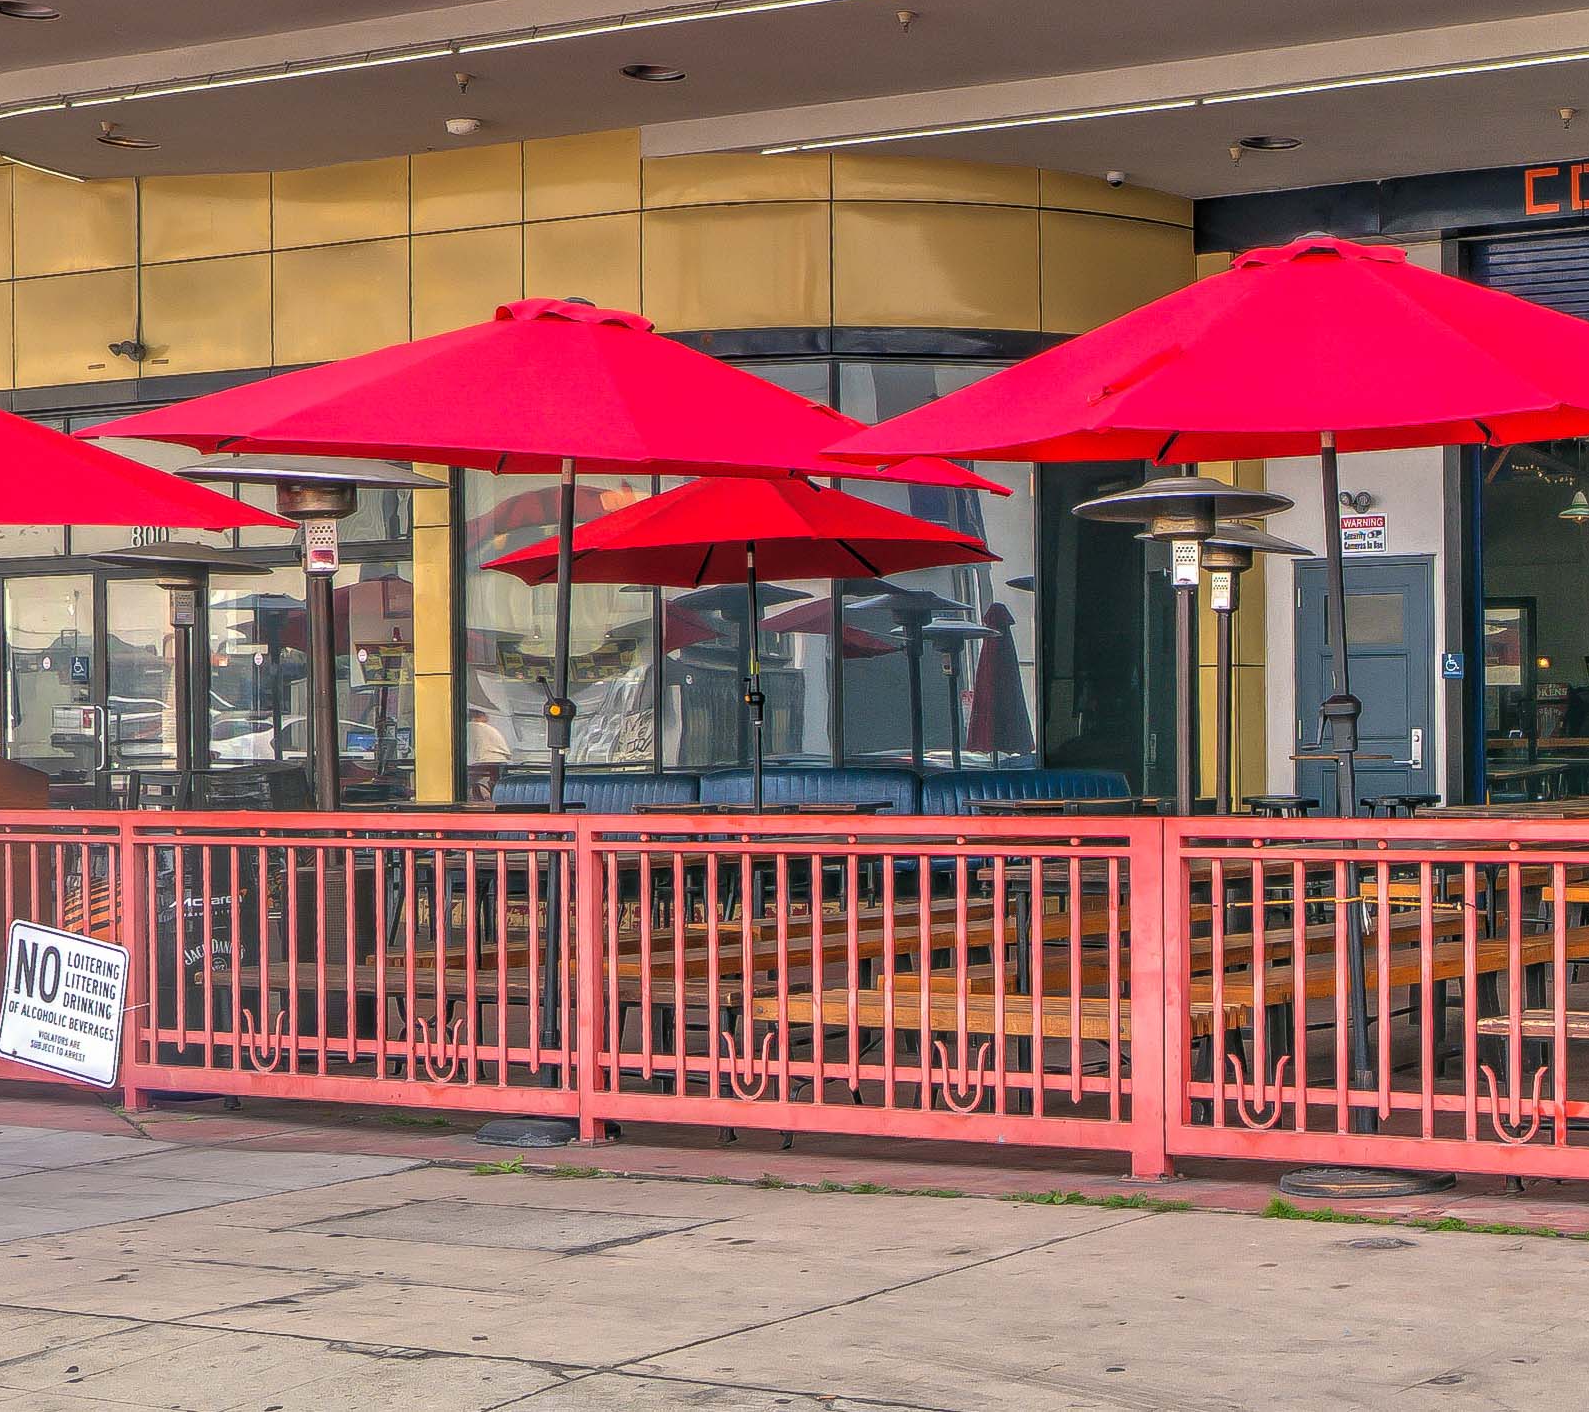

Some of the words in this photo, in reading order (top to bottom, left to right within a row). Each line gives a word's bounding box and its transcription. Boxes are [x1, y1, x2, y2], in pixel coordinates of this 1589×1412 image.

[132, 525, 169, 547] 800
[1342, 518, 1384, 528] WARNING
[14, 939, 61, 1004] NO
[67, 951, 120, 980] LOITERING
[65, 972, 116, 1000] LITTERING
[63, 992, 112, 1020] DRINKING
[9, 1000, 20, 1014] OF
[21, 1004, 67, 1028] ALCOHOLIC
[69, 1017, 114, 1042] BEVERAGES
[30, 1040, 55, 1055] SUBJECT
[56, 1046, 63, 1056] TO
[64, 1049, 86, 1063] ARREST
[38, 1030, 68, 1047] VIOLATORS
[70, 1040, 80, 1050] ARE
